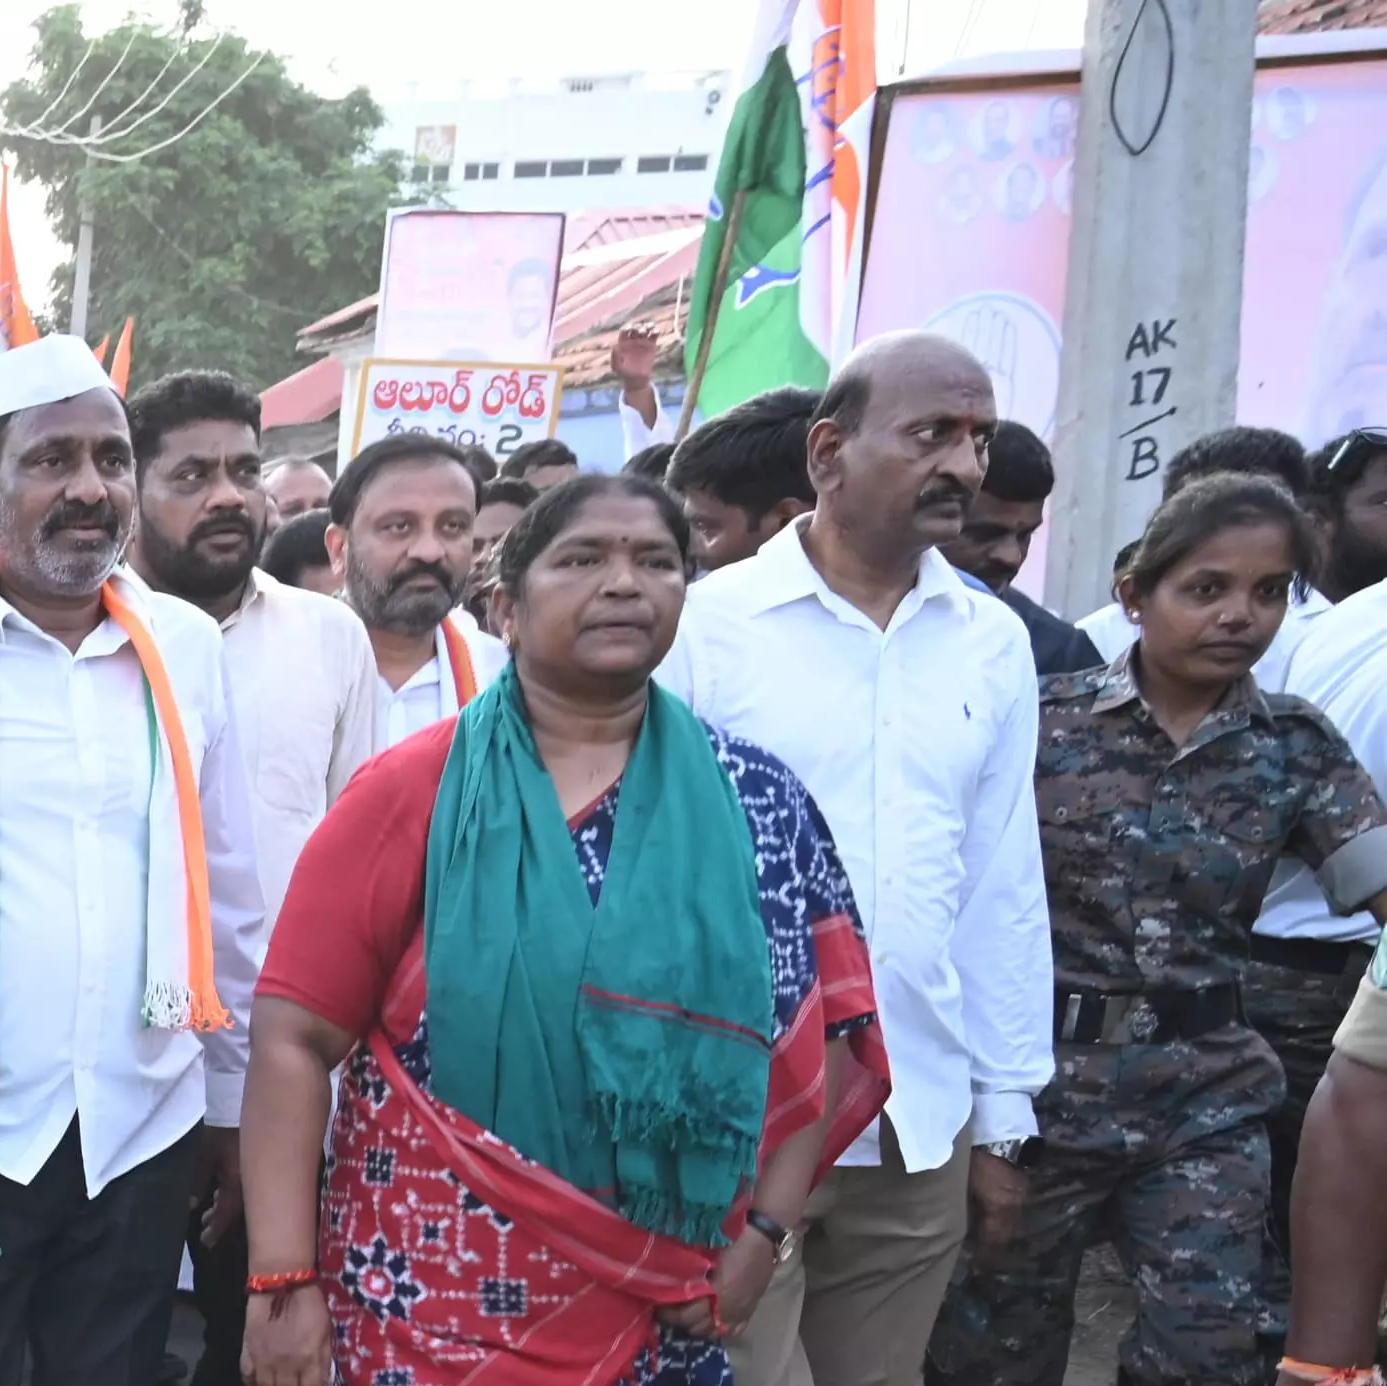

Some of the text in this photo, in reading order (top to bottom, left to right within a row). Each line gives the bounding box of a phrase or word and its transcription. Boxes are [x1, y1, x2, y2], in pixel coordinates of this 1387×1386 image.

[1125, 318, 1178, 362] AK
[372, 367, 548, 418] ఆలూర్ రోడ్
[1129, 366, 1172, 407] 17
[495, 423, 524, 455] 2
[1125, 436, 1160, 481] B
